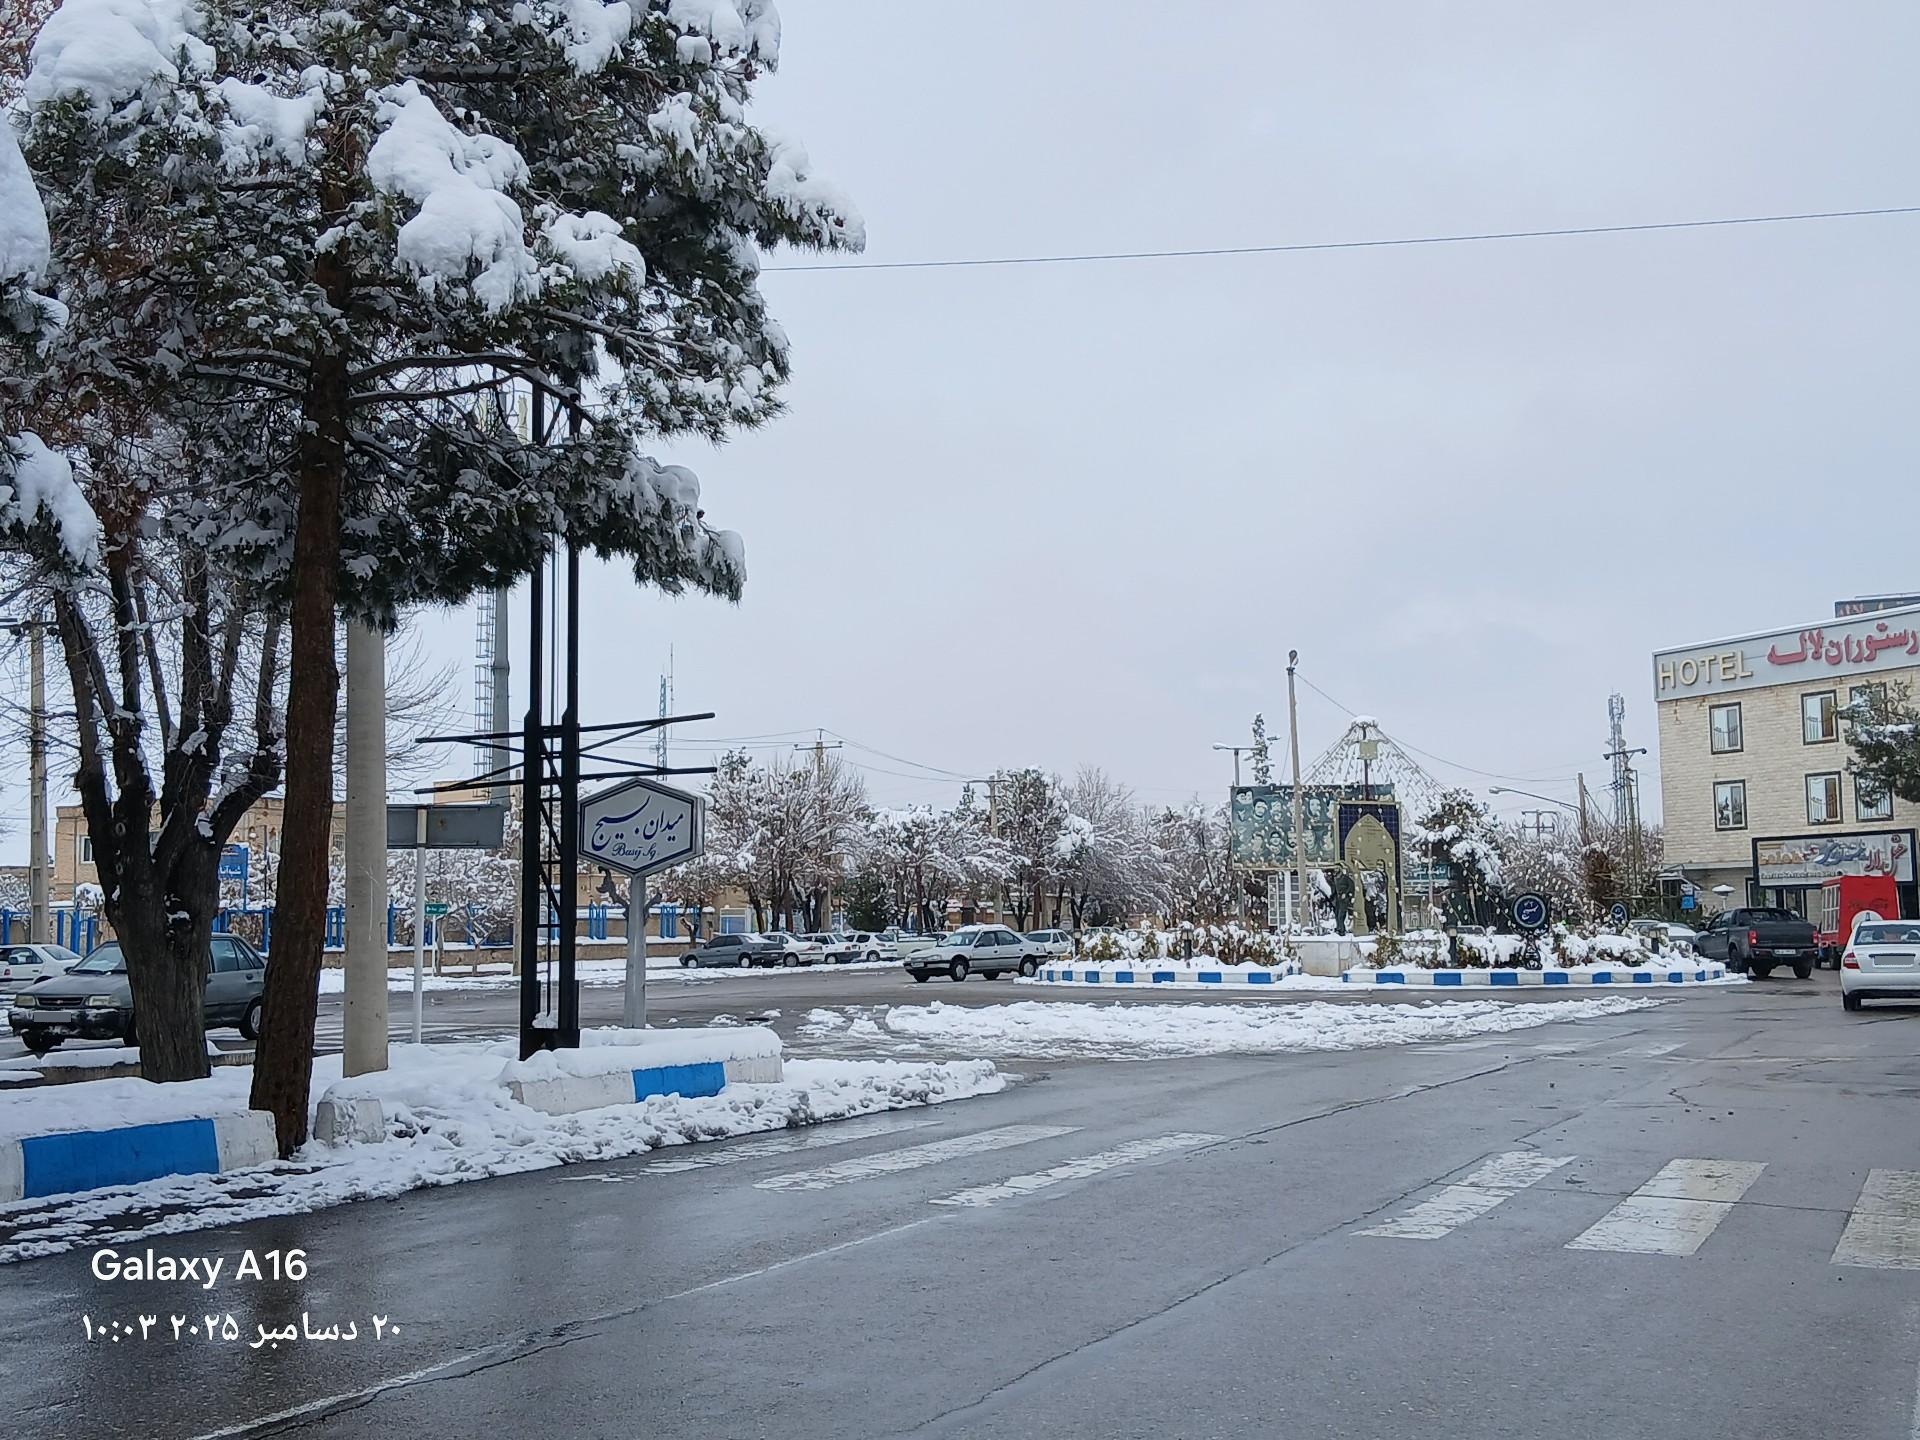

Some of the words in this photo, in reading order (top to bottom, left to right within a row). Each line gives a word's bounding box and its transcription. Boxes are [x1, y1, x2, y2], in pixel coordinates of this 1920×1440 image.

[1766, 627, 1824, 666] لاله
[1824, 622, 1920, 666] رستوران
[1658, 650, 1753, 690] HOTEL
[591, 795, 651, 851] بسیج
[642, 809, 685, 842] میدان
